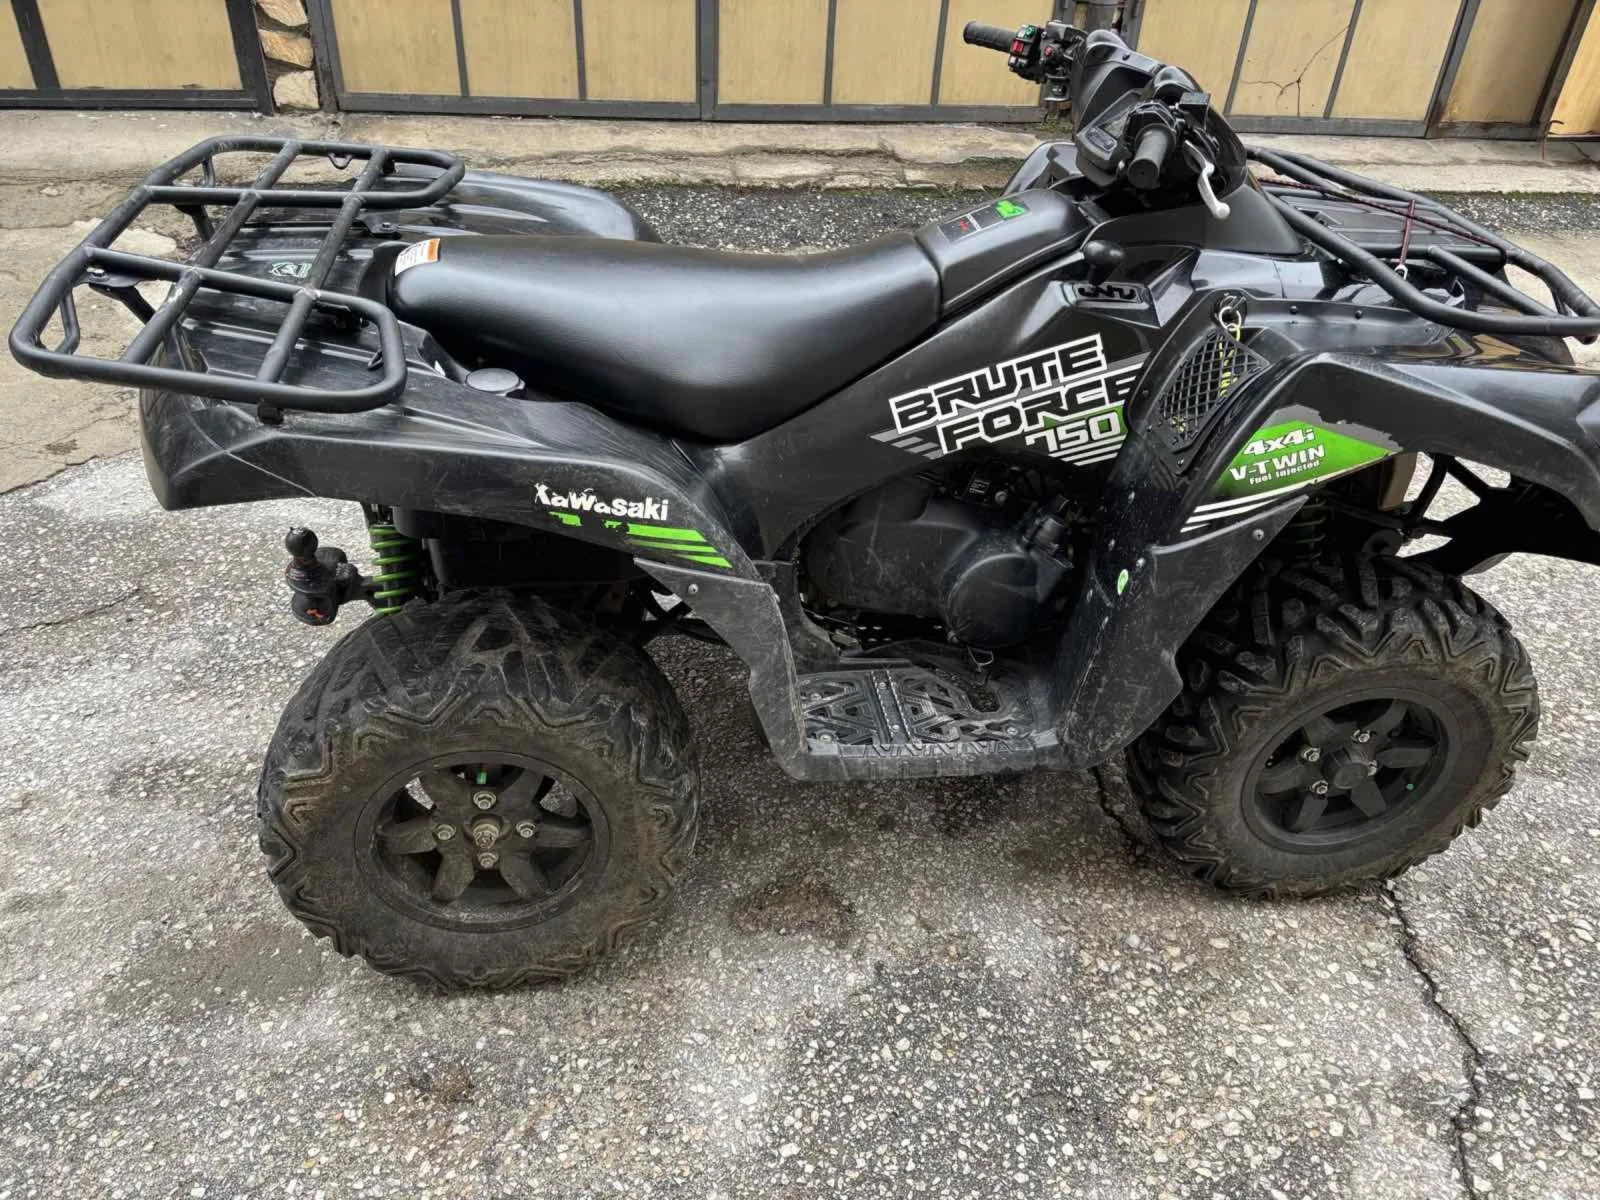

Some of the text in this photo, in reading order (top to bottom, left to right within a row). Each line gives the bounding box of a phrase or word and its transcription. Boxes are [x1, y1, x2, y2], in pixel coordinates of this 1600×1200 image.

[888, 332, 1108, 435] BRUTE
[936, 361, 1144, 455] FORCE
[1025, 411, 1122, 453] 750
[1243, 427, 1316, 456] 4x4i
[1229, 444, 1326, 481] V-TWIN
